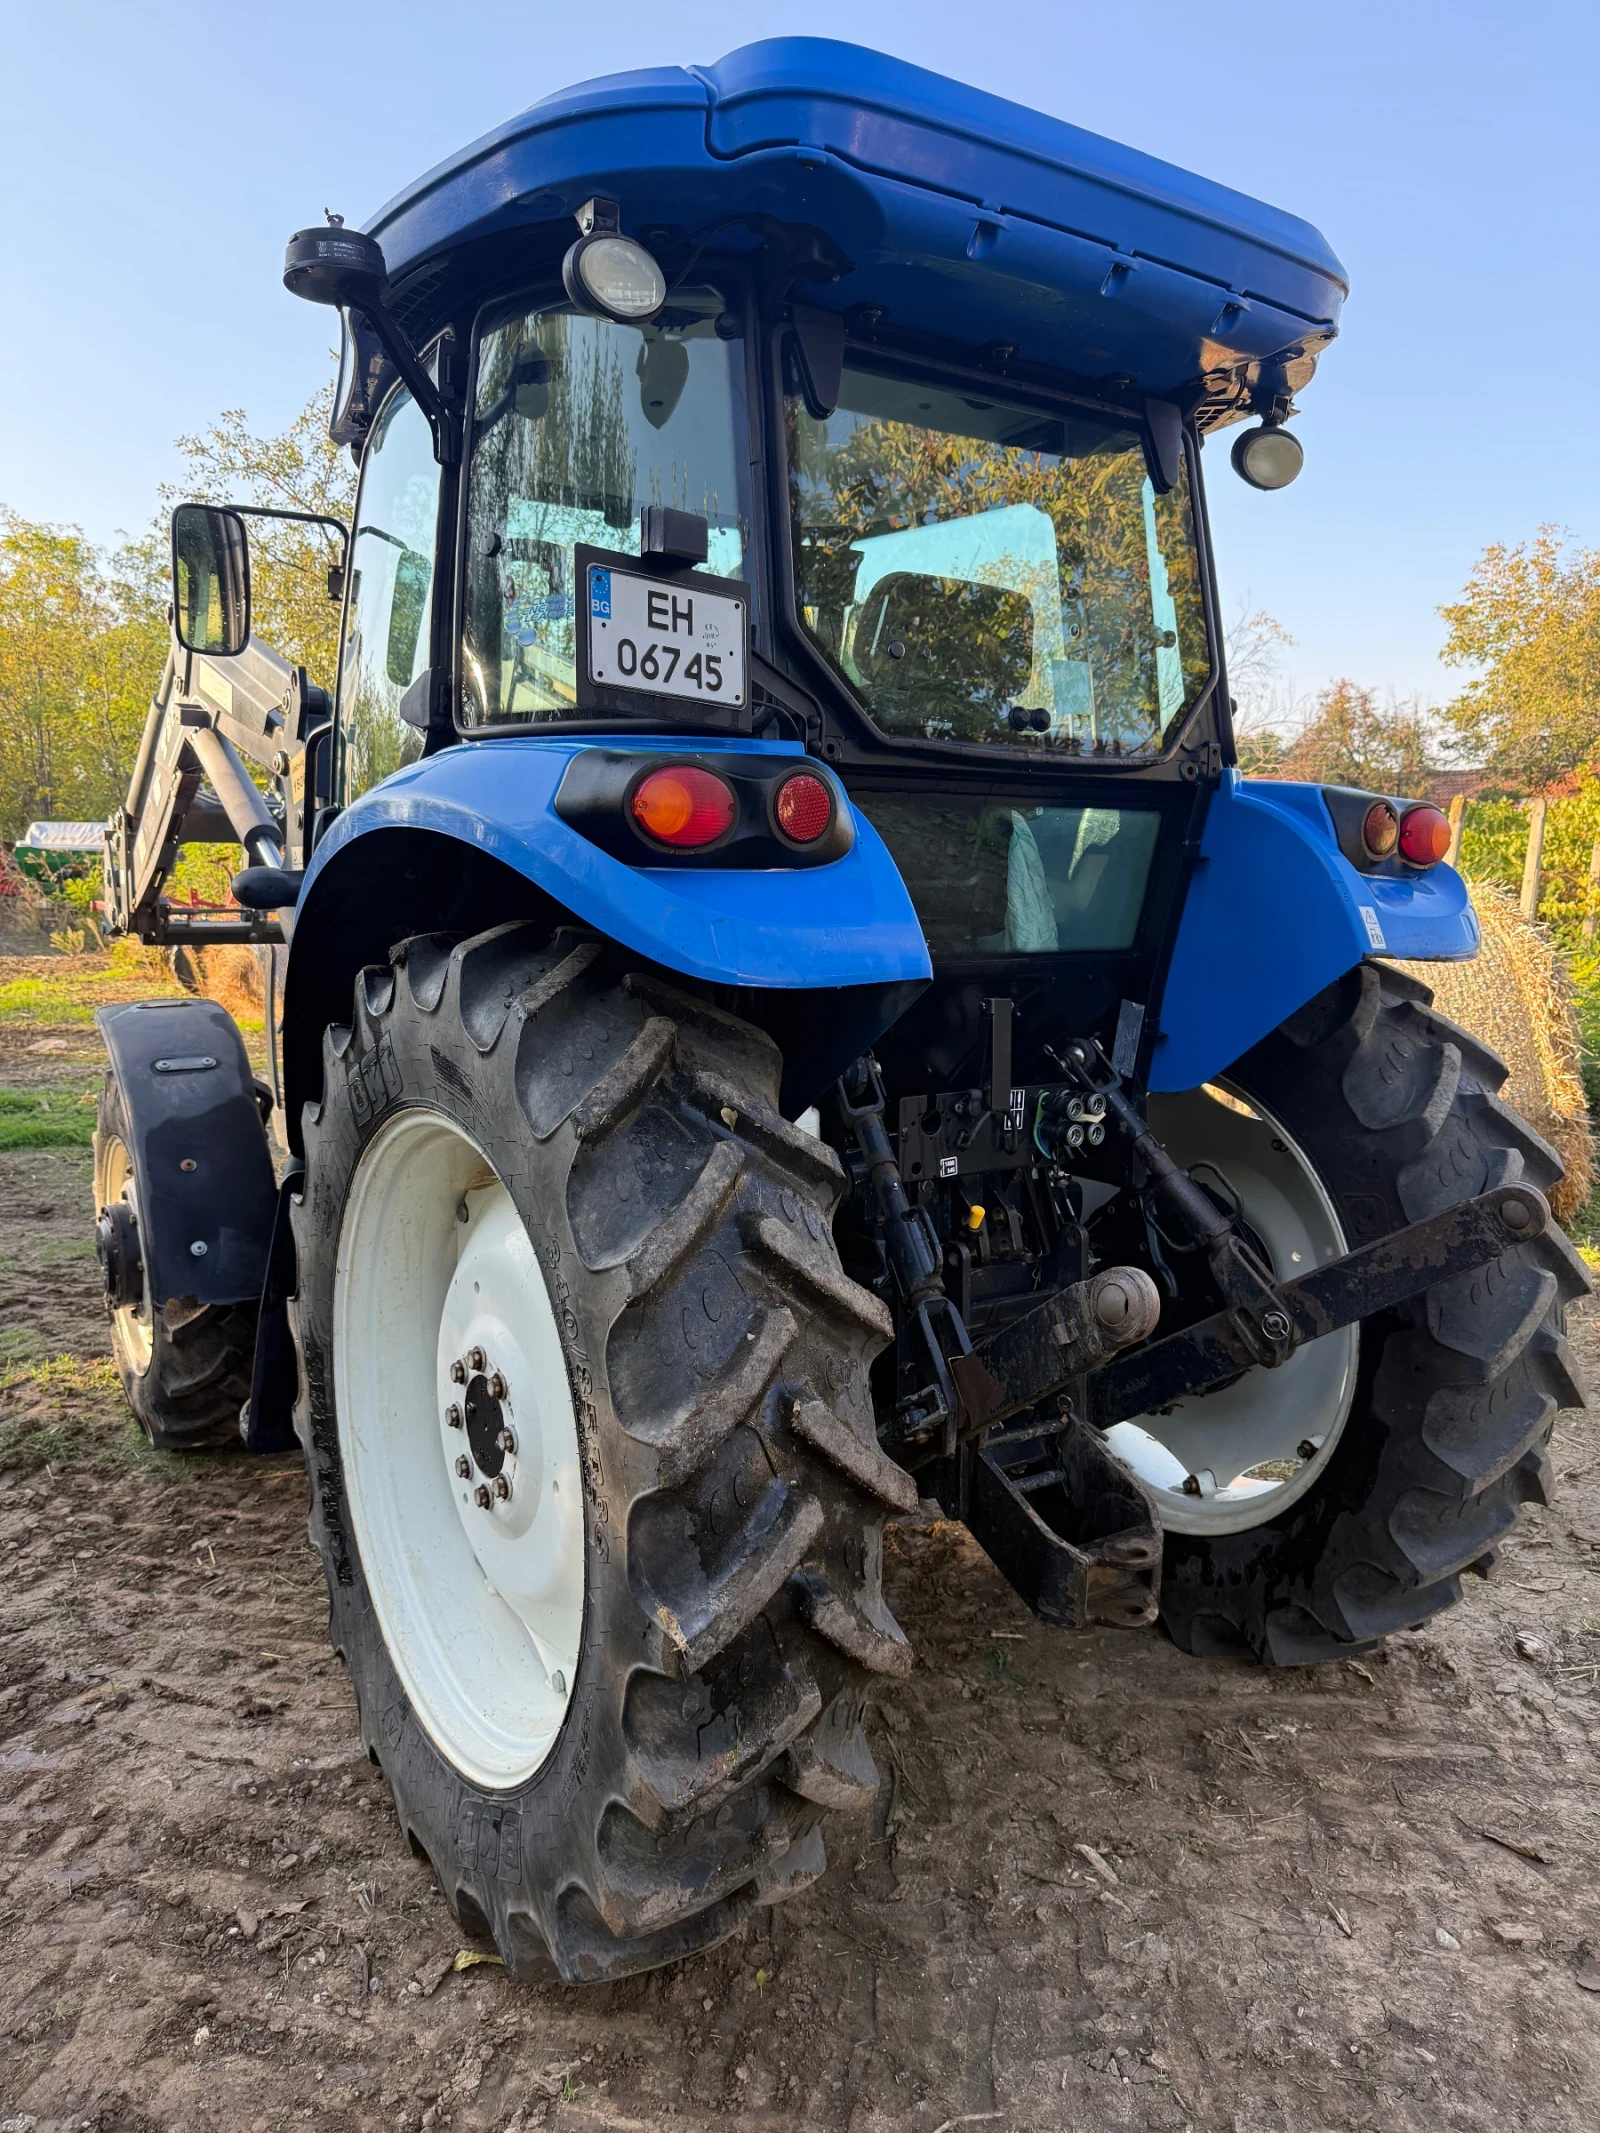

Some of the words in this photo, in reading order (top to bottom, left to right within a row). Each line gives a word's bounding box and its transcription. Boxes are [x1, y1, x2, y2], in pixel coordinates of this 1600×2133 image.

[532, 593, 573, 606] CLEAN
[592, 599, 610, 614] BG
[522, 601, 573, 616] ENERGY
[525, 609, 574, 623] LEADER
[647, 590, 694, 636] EH
[617, 638, 723, 692] 06745
